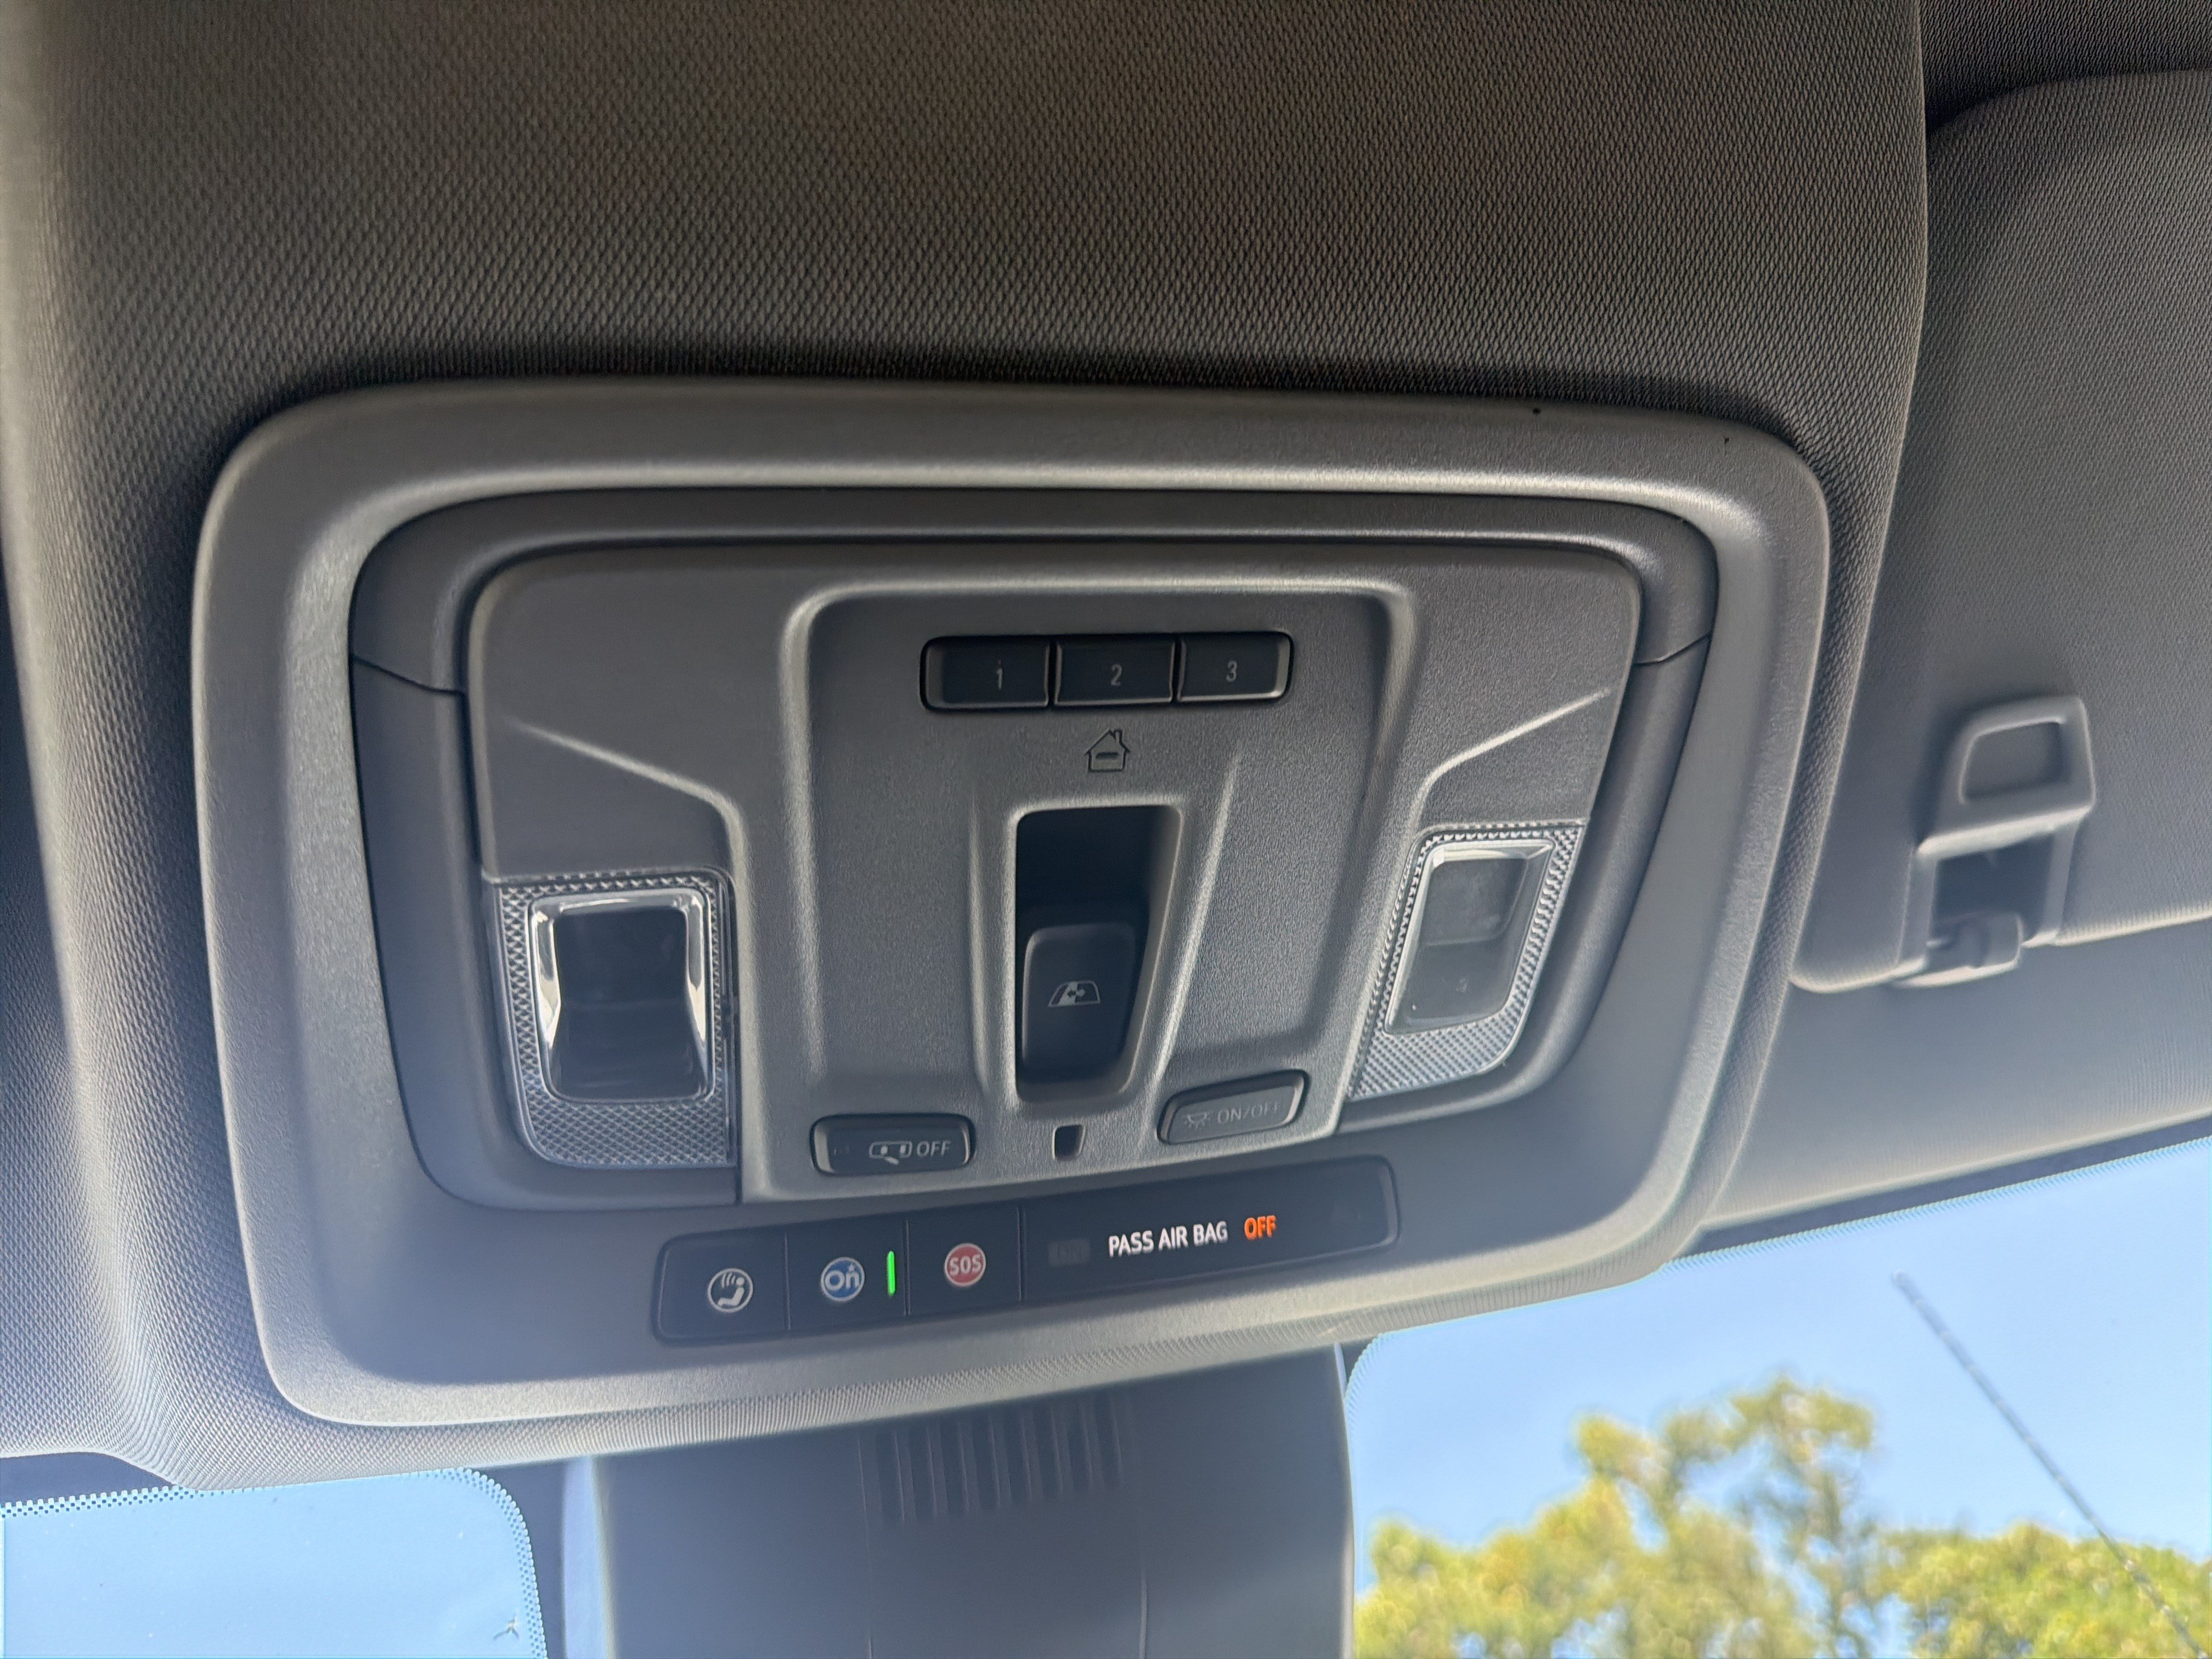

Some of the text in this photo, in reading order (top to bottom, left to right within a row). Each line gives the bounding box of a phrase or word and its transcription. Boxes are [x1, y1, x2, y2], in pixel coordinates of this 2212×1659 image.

[996, 667, 1003, 690] 1
[1110, 663, 1122, 687] 2
[1225, 659, 1238, 683] 3
[1217, 1101, 1281, 1125] ON/OFF
[916, 1140, 952, 1158] OFF
[1108, 1215, 1277, 1258] PASS AIR BAG OFF
[949, 1254, 981, 1276] SOS
